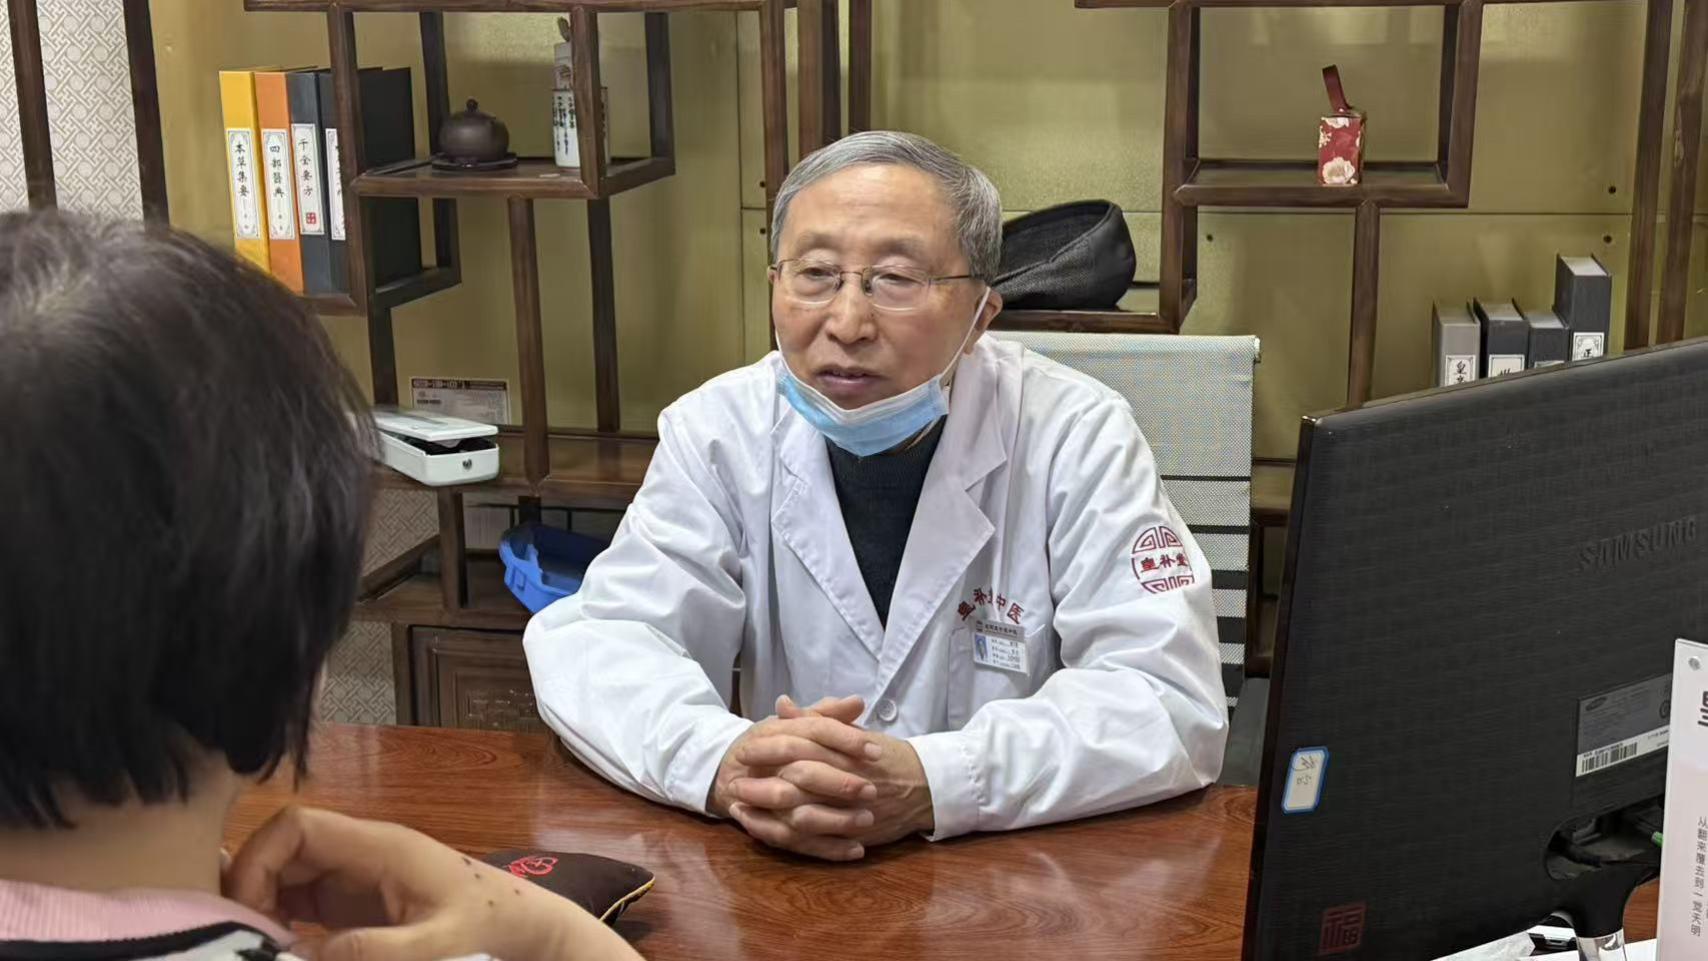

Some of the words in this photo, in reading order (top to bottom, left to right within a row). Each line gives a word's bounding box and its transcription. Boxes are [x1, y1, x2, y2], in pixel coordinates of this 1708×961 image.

[235, 142, 250, 198] 本草集要
[298, 138, 313, 197] 千金要方
[1578, 515, 1697, 572] SAMSUNG
